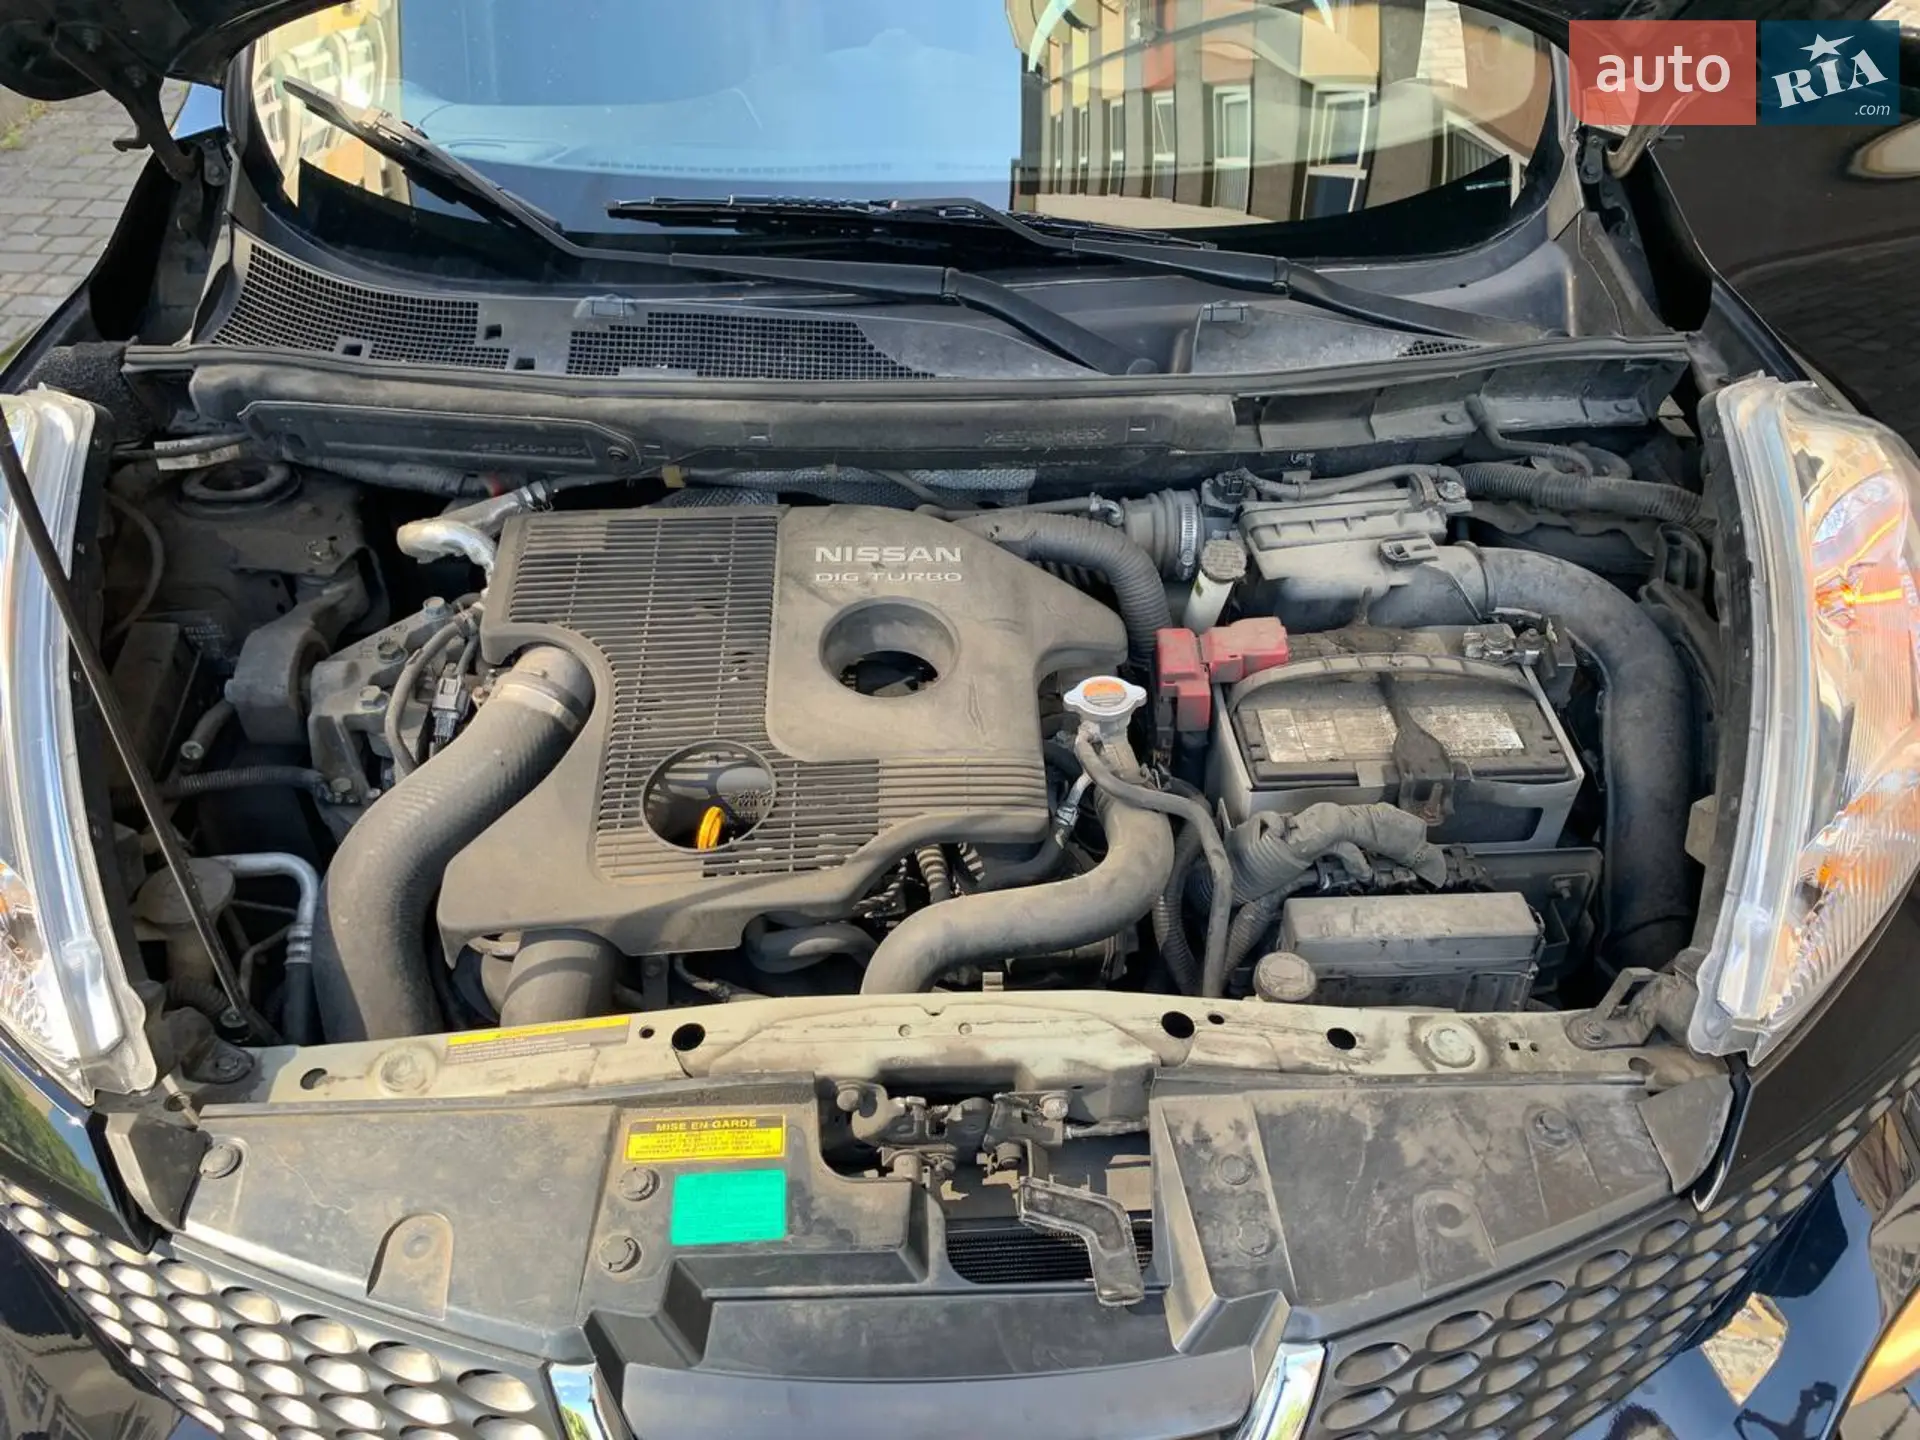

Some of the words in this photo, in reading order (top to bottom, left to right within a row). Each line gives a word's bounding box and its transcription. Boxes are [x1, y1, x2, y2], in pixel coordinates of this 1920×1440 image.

[815, 546, 962, 563] NISSAN
[815, 572, 859, 582] DIG
[869, 572, 963, 582] TURBO
[656, 1122, 687, 1132] MISE
[691, 1121, 709, 1130] EN
[711, 1118, 757, 1129] GARDE
